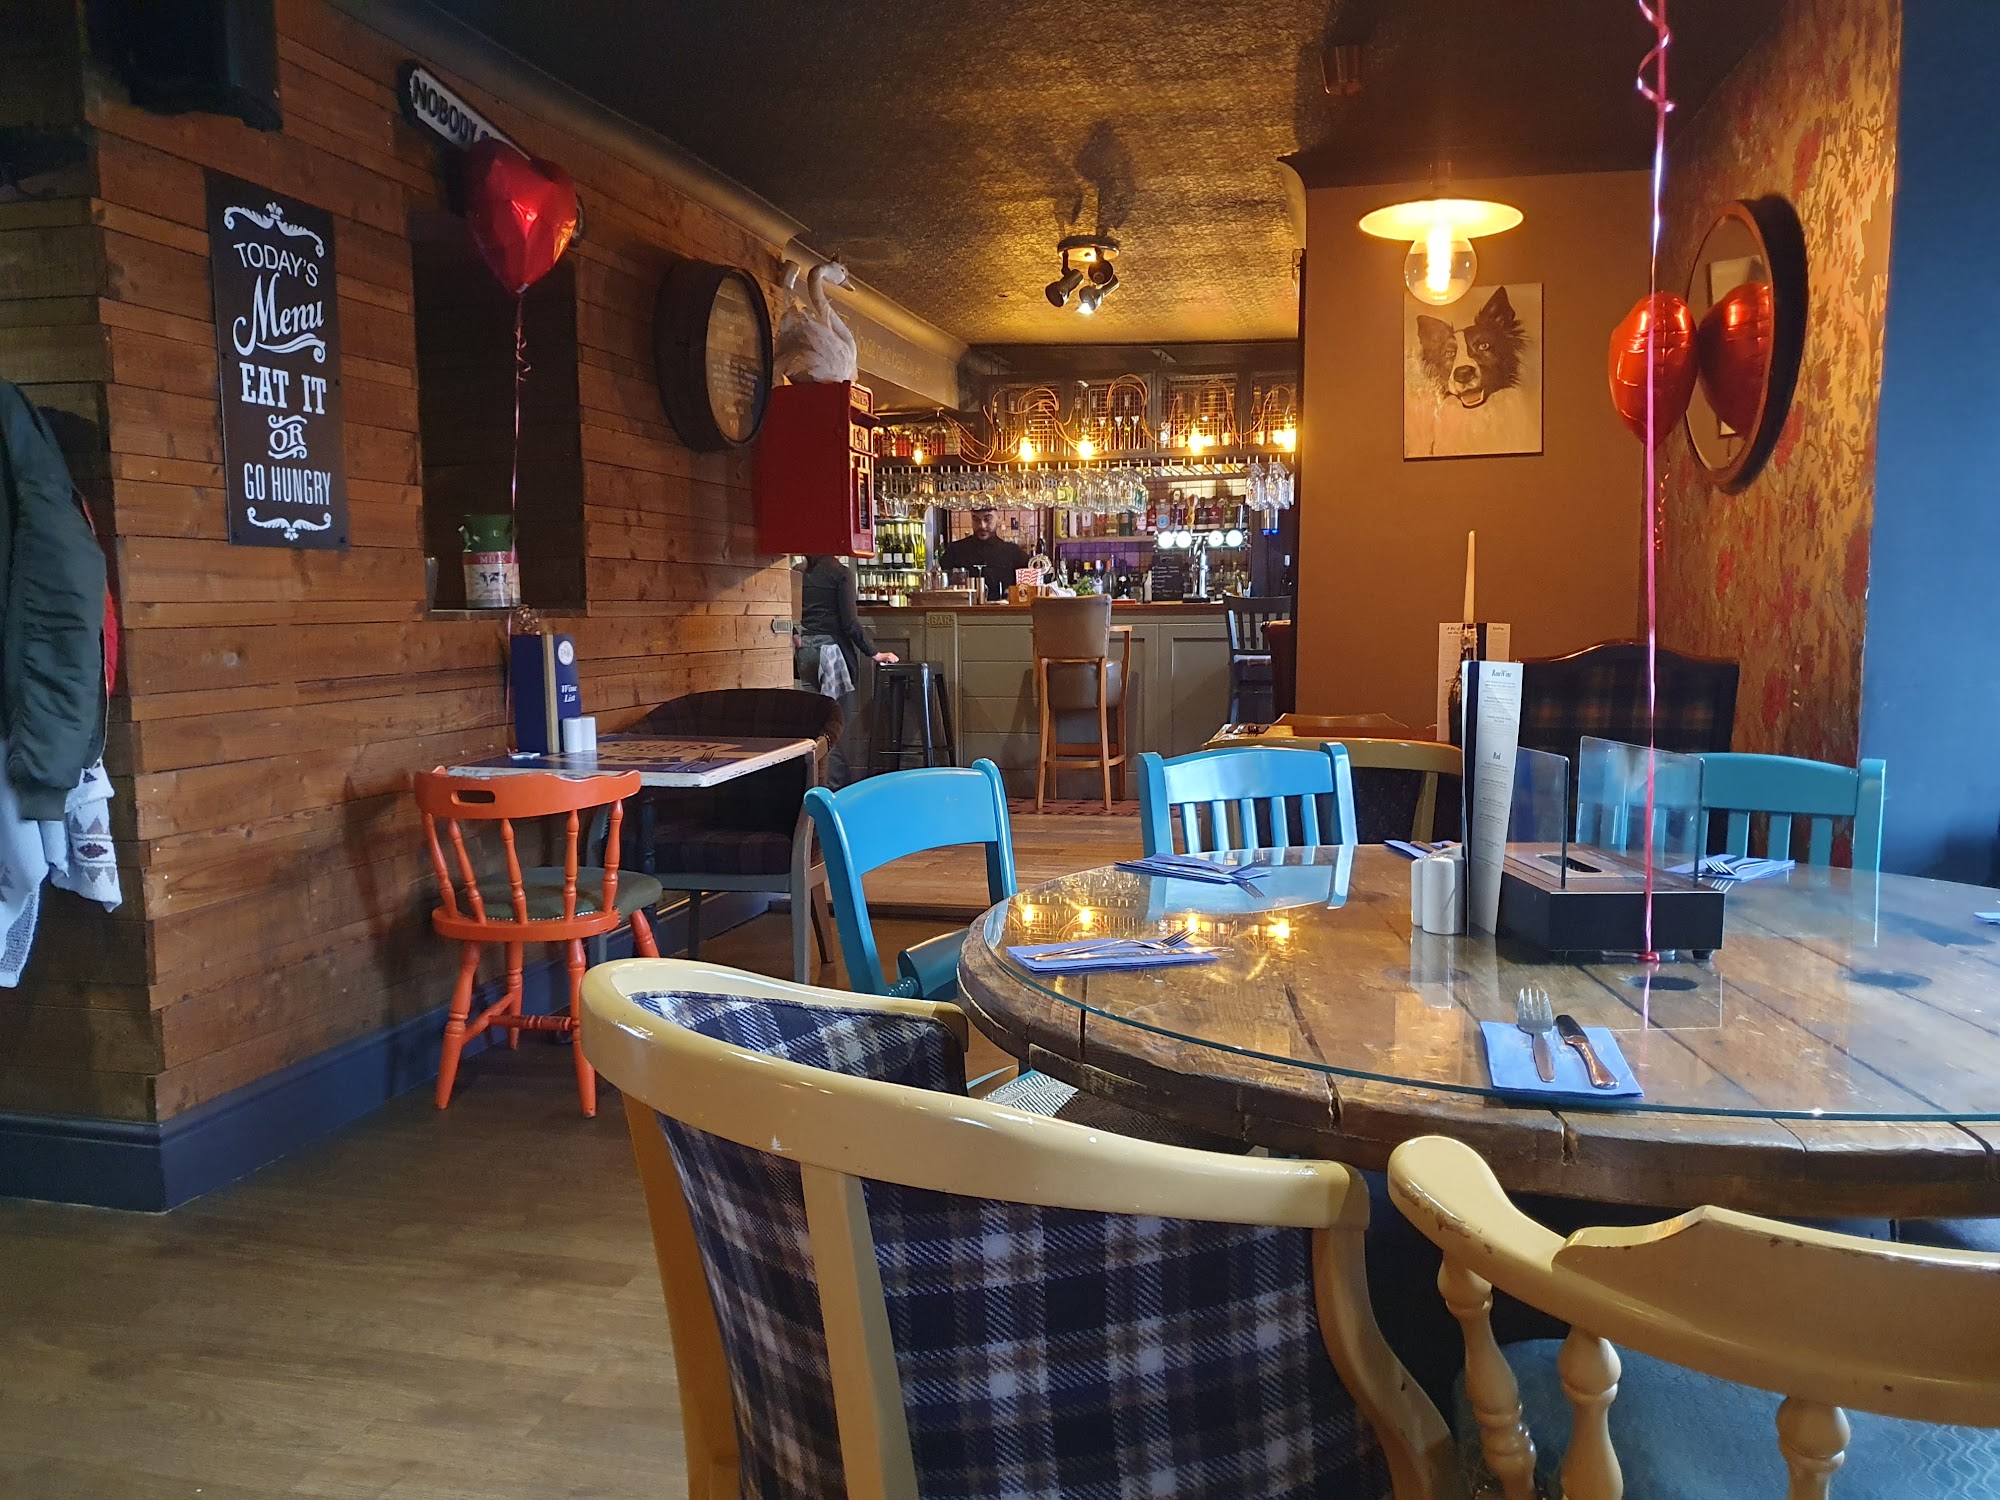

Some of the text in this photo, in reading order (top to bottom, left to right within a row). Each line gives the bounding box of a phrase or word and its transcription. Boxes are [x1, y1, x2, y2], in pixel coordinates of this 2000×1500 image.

[412, 75, 478, 143] NOBODY
[233, 242, 319, 287] TODAY'S
[232, 272, 325, 356] Menu
[239, 361, 327, 415] EAT IT
[269, 422, 307, 451] OR
[243, 462, 331, 506] GO HUNGRY
[931, 615, 951, 625] BAR
[561, 684, 577, 693] Wine
[564, 694, 576, 703] List
